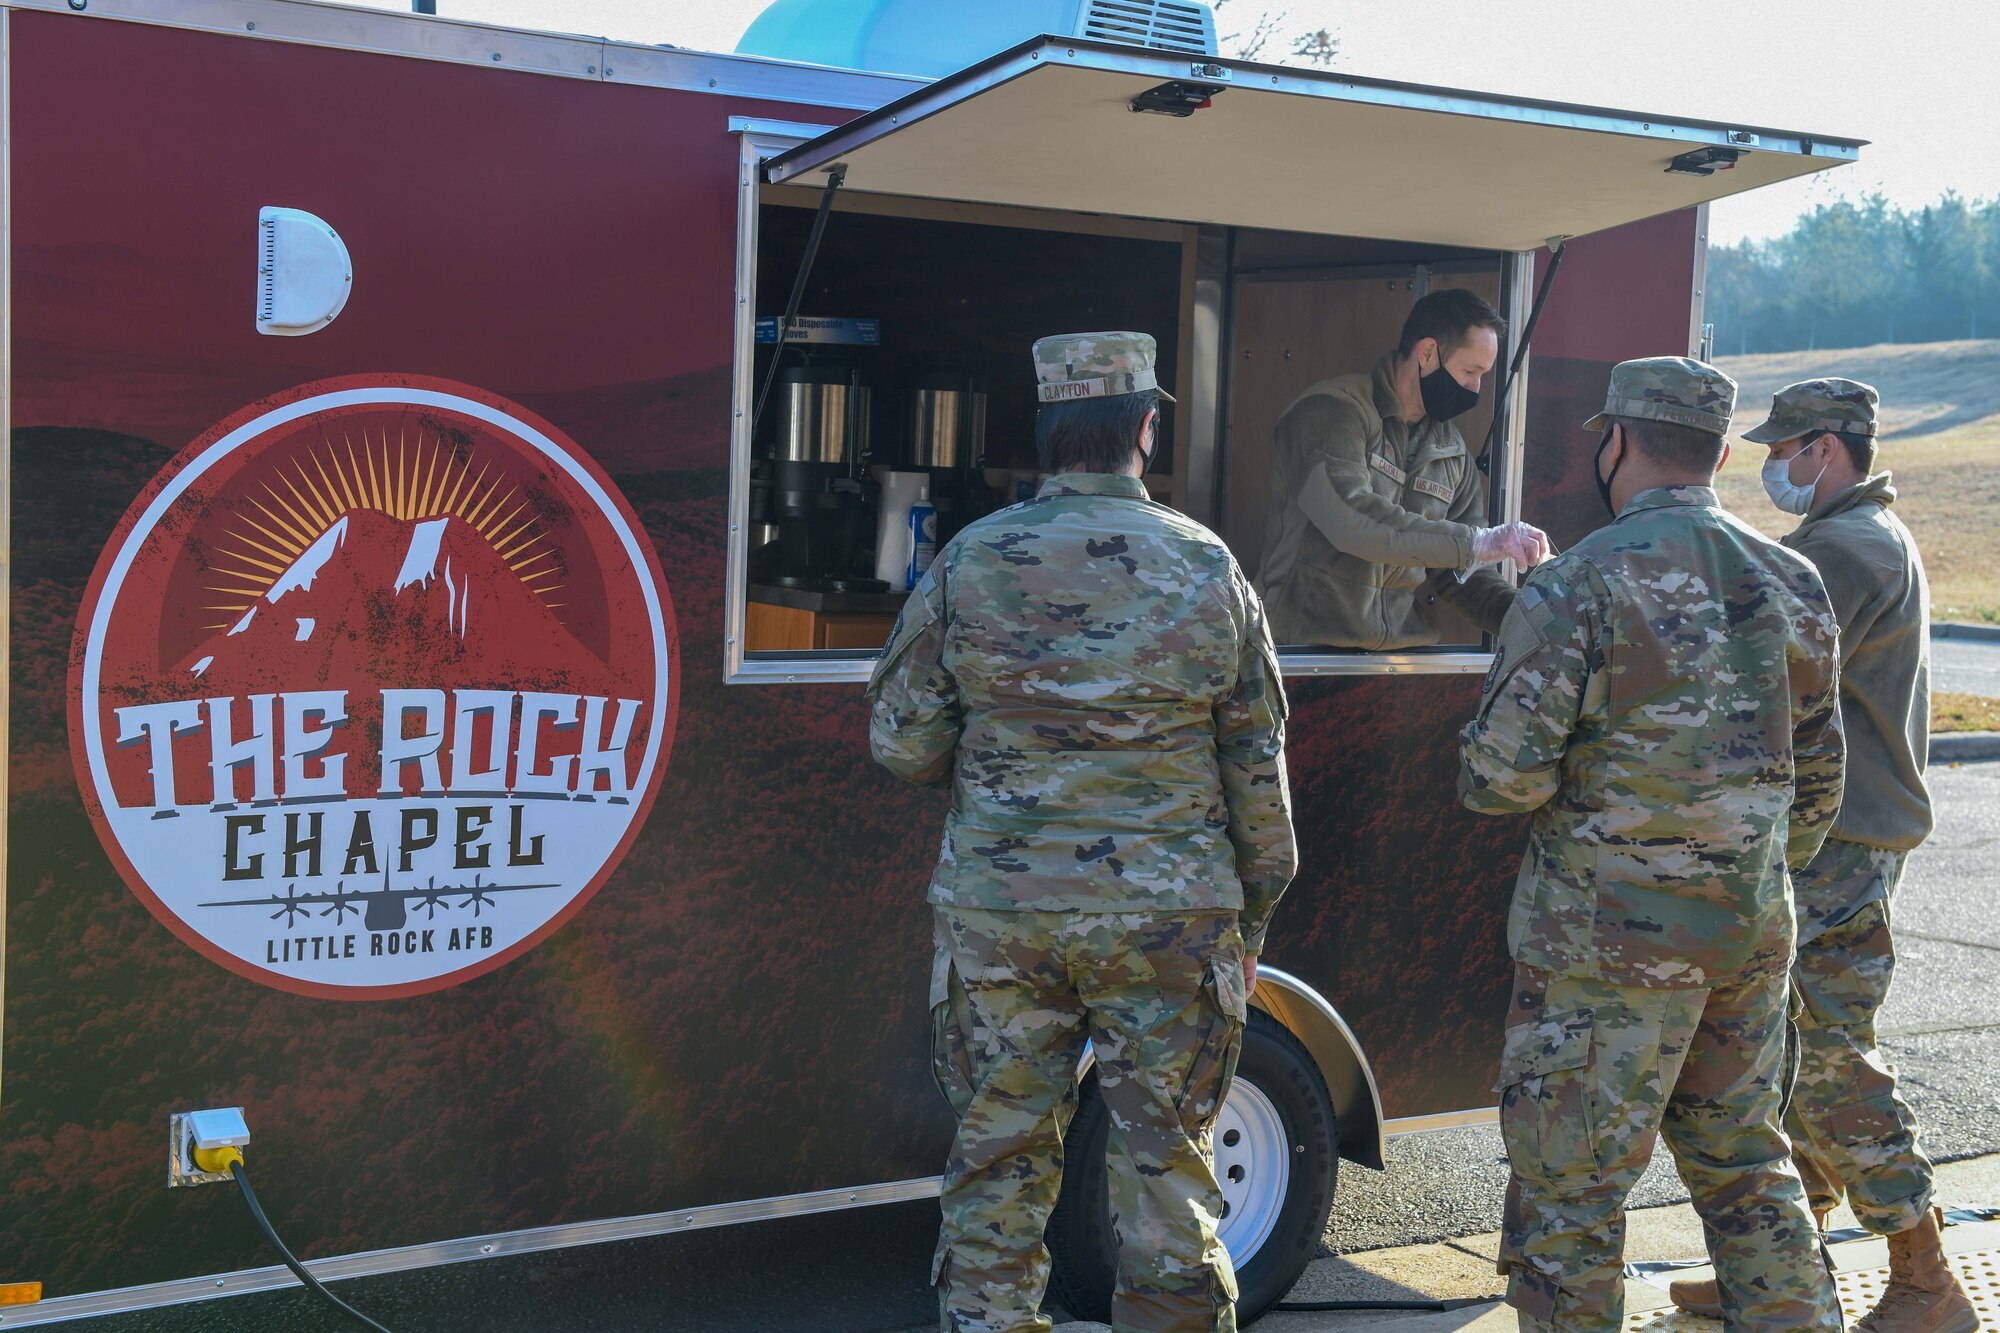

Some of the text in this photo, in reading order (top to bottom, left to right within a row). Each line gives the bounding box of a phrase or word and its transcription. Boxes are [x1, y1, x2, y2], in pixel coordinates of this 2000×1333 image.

[799, 318, 844, 329] Disposable
[781, 329, 808, 339] loves
[1044, 382, 1090, 400] CLAYTON
[1428, 482, 1438, 493] AIR
[1438, 485, 1453, 501] FORCE
[114, 688, 643, 814] THE ROCK
[222, 805, 546, 881] CHAPEL
[266, 926, 493, 963] LITTLE ROCK AFB
